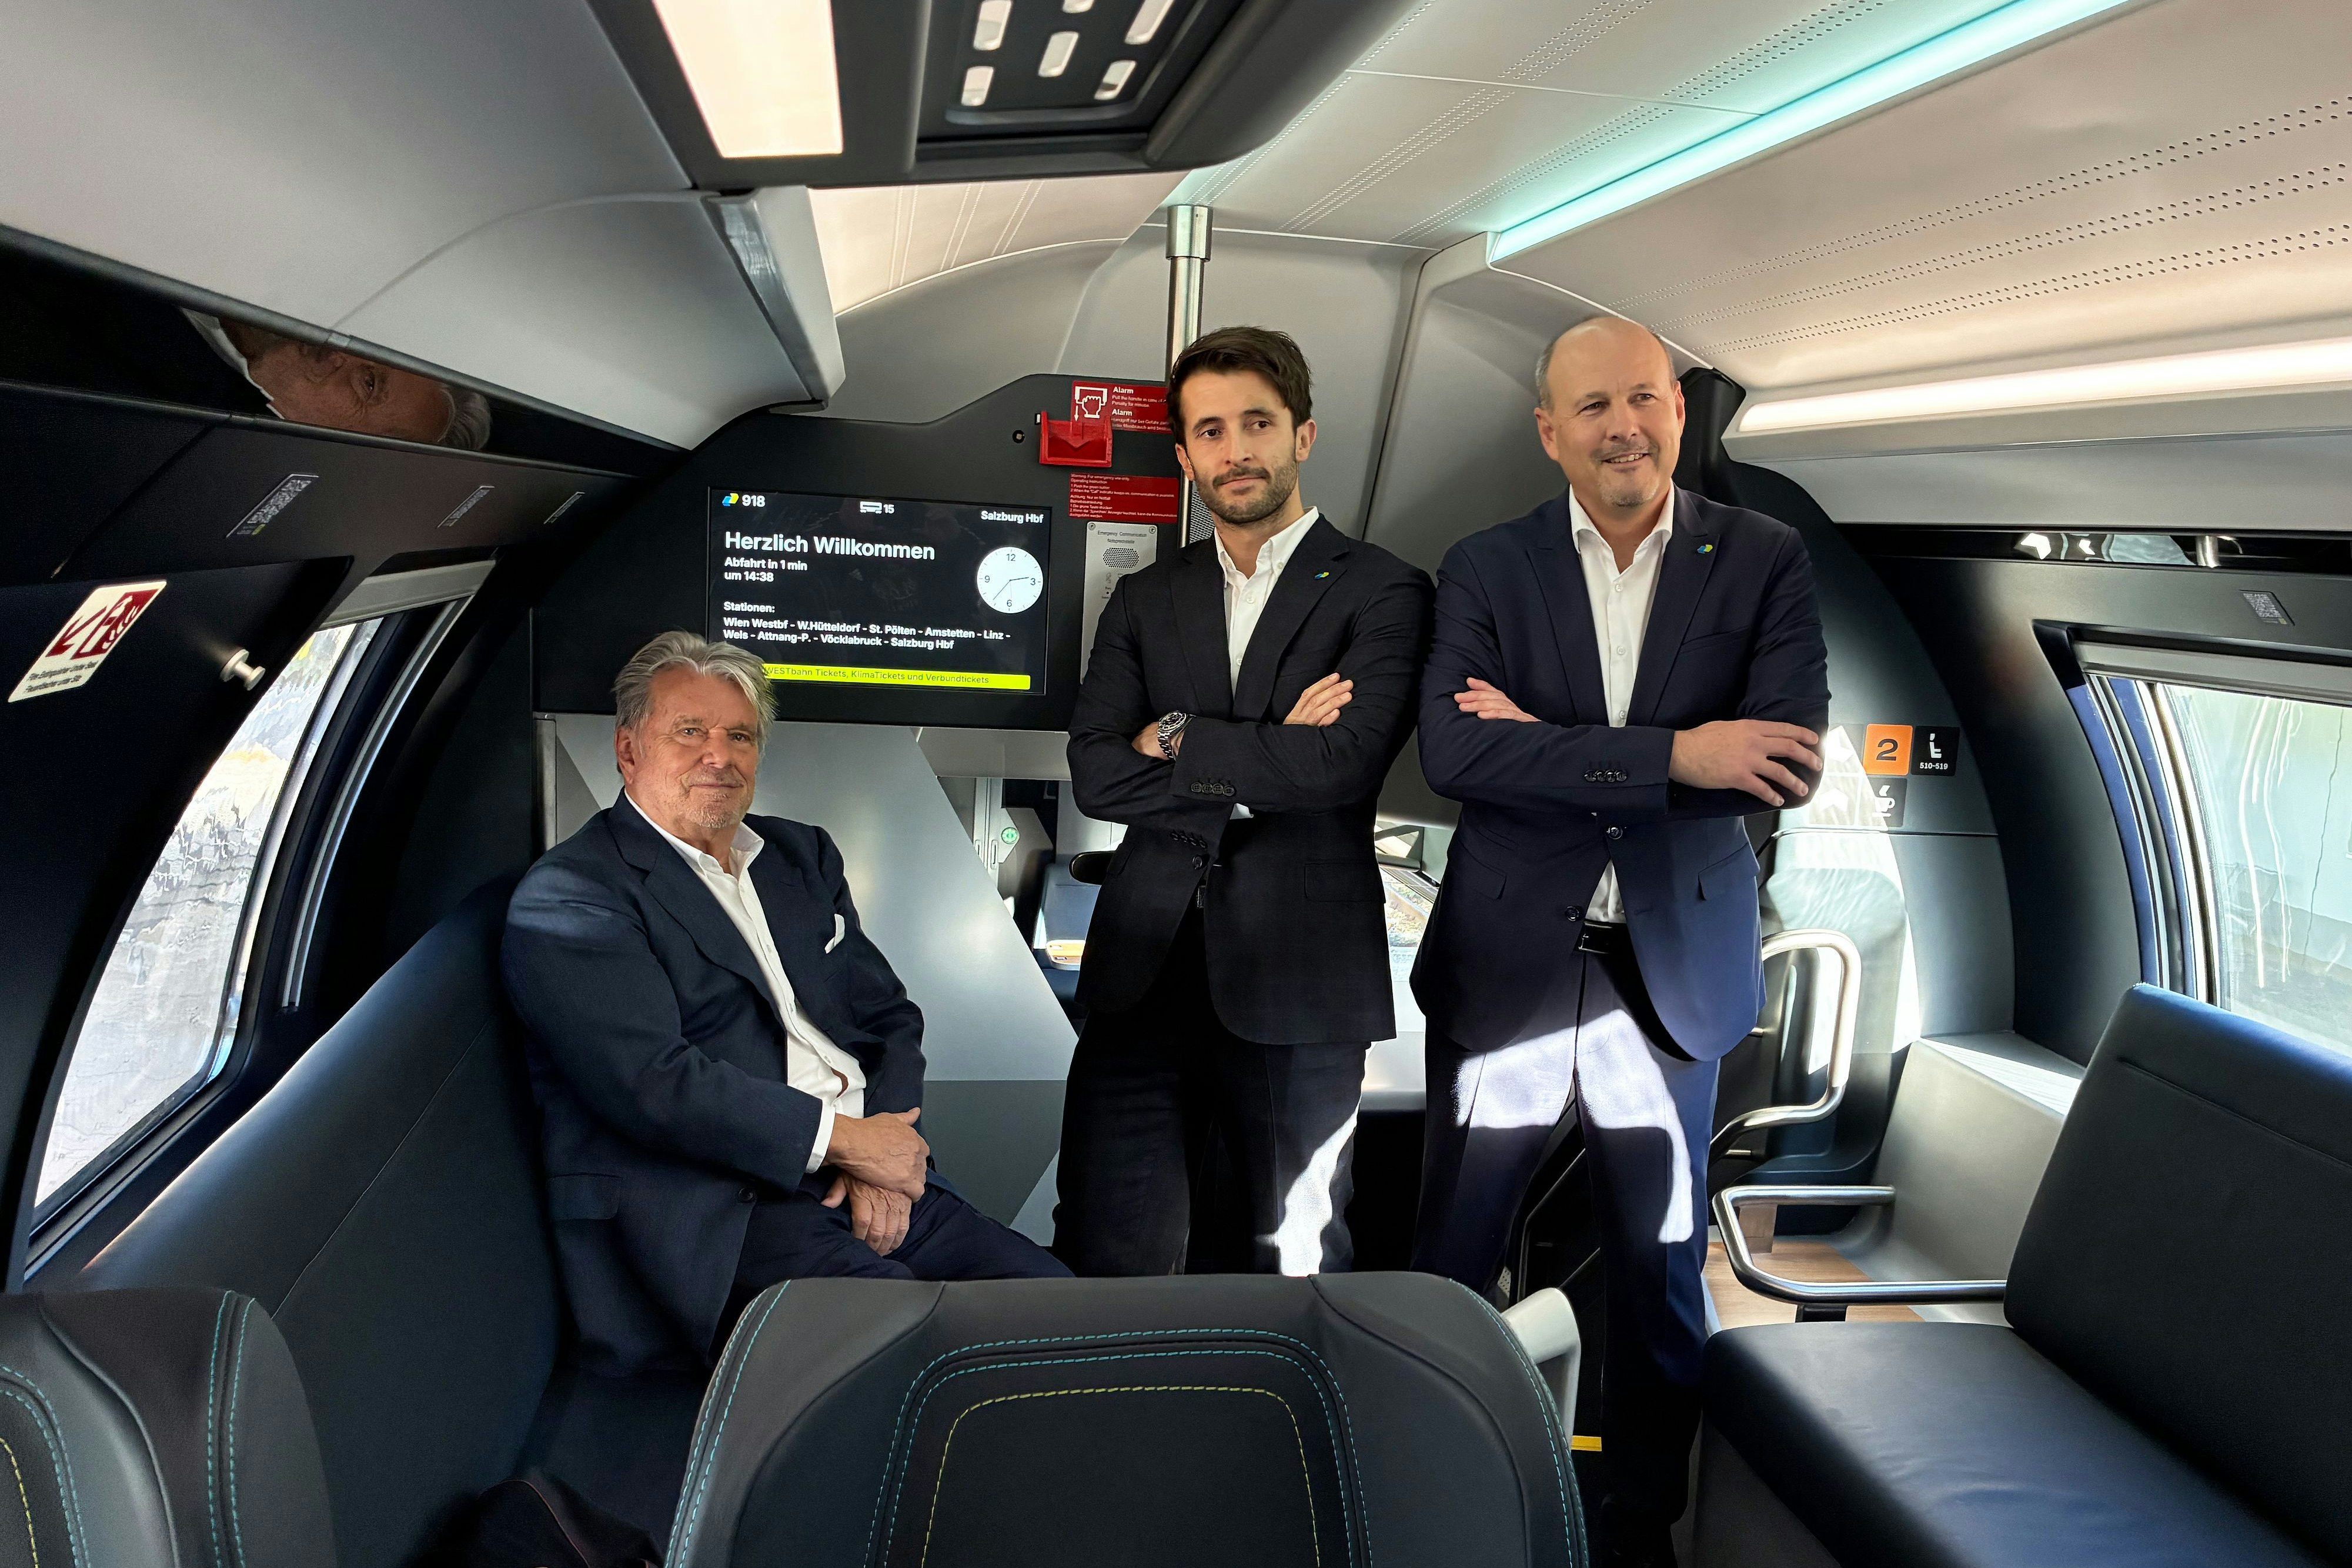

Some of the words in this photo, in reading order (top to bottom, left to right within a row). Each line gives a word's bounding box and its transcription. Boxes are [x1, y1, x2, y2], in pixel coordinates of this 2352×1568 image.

[741, 494, 766, 507] 918
[883, 504, 895, 514] 15
[981, 510, 1024, 524] Salzburg
[1025, 513, 1044, 523] Hbf
[725, 531, 808, 553] Herzlich
[813, 536, 935, 560] Willkommen
[724, 557, 766, 569] Abfahrt
[767, 559, 779, 570] in
[780, 559, 786, 570] 1
[787, 560, 808, 571] min
[724, 571, 742, 581] um
[743, 571, 774, 582] 14:38
[723, 601, 775, 613] Stationen:
[723, 617, 750, 627] Wien
[751, 618, 789, 629] Westbf
[797, 620, 861, 633] W.Hütteldorf
[869, 624, 883, 634] St.
[884, 624, 916, 636] Pölten
[924, 627, 975, 638] Amstetten
[984, 630, 1004, 640] Linz
[723, 629, 749, 640] Wels
[757, 631, 811, 643] Attnang-P.
[820, 634, 883, 646] Vöcklabruck
[890, 637, 934, 650] Salzburg
[936, 639, 955, 650] Hbf
[765, 667, 813, 676] WESTbahn
[816, 668, 848, 678] Tickets,
[851, 671, 905, 680] KlimaTickets
[926, 674, 989, 683] Verbundtickets
[1876, 738, 1898, 761] 2
[1919, 762, 1949, 770] 510-519
